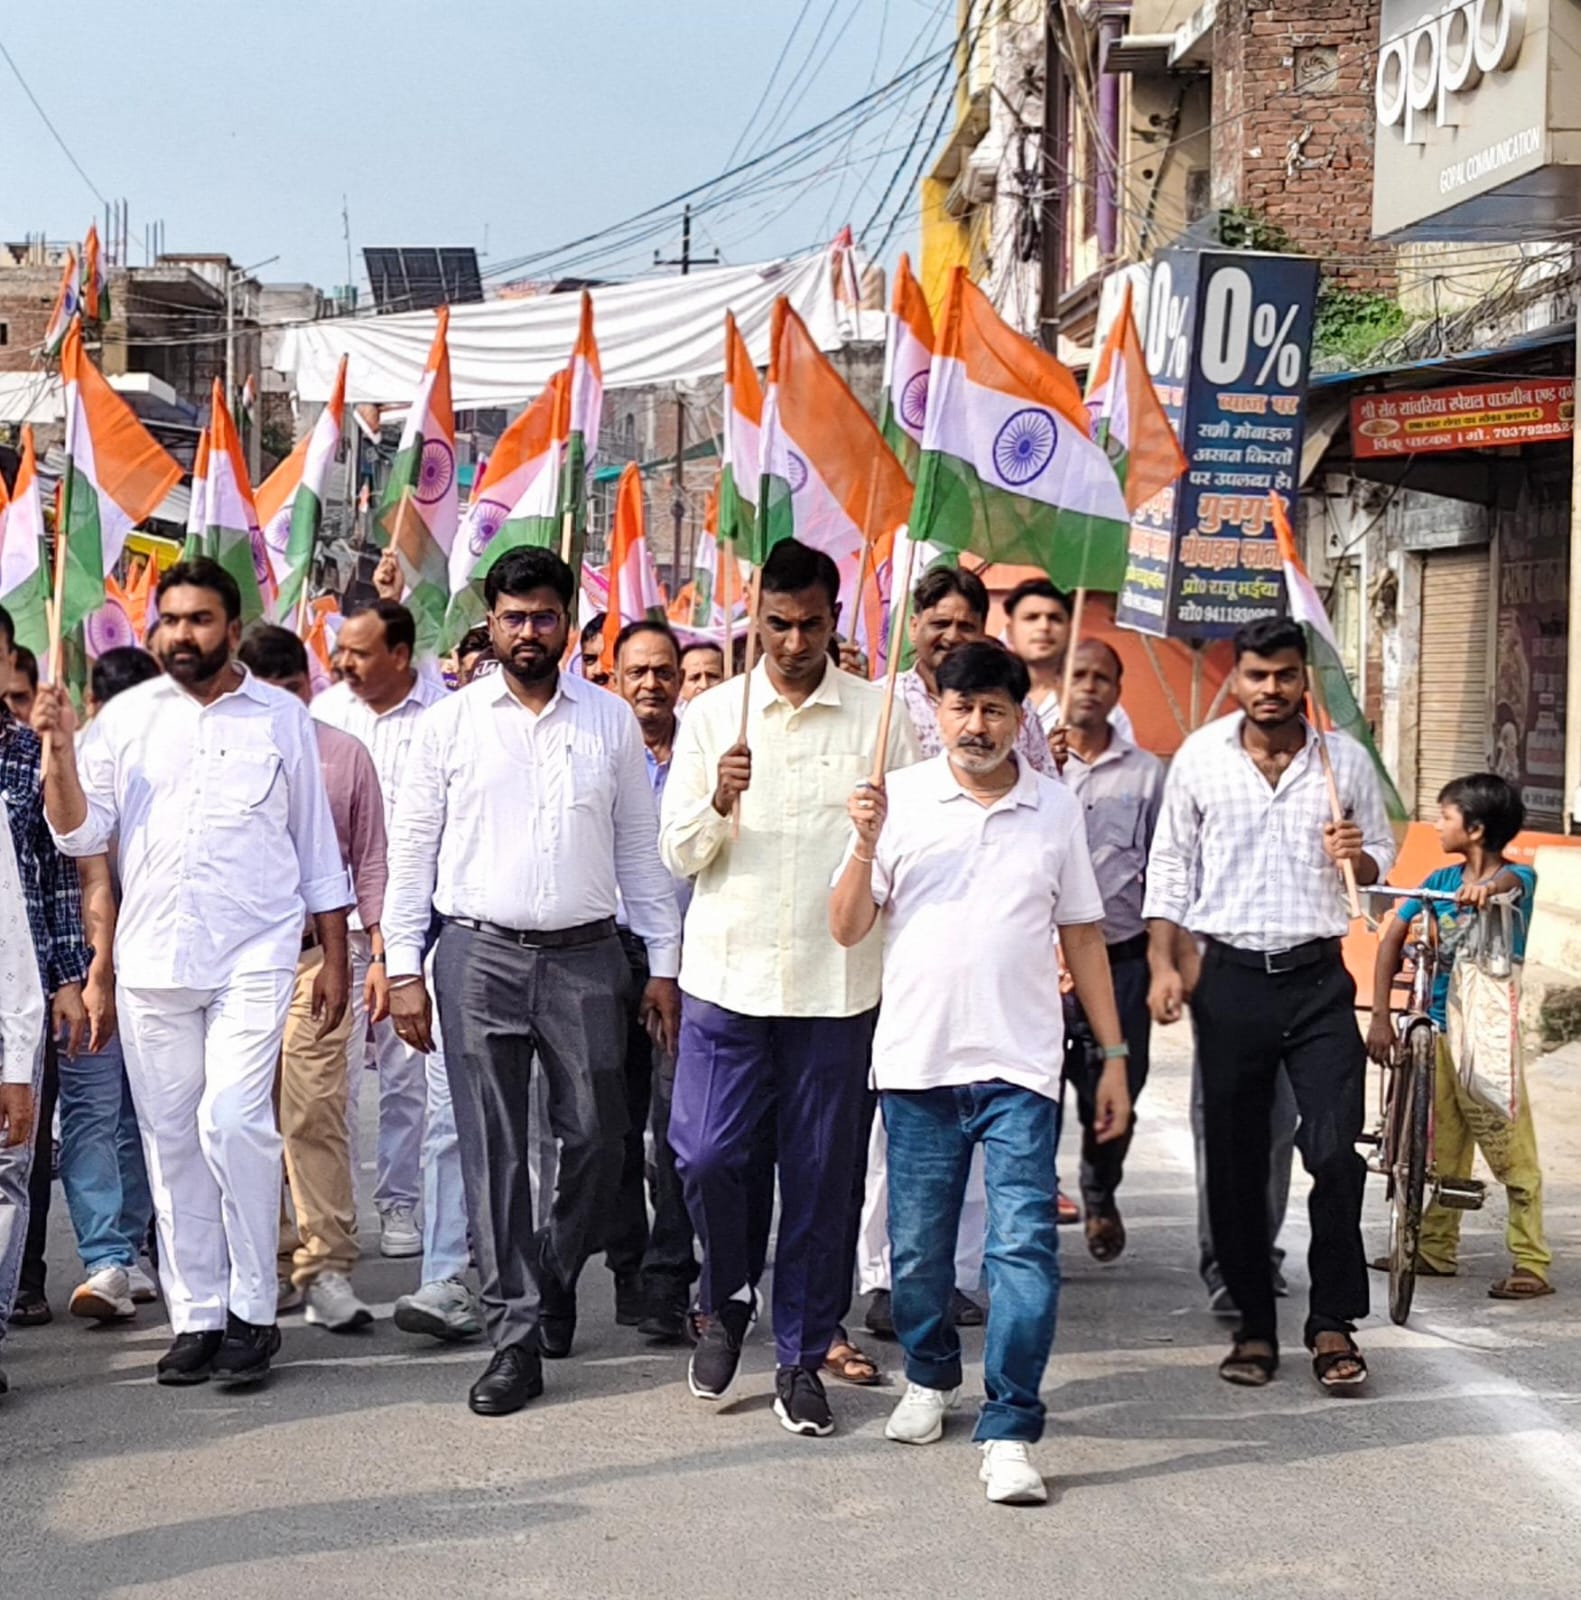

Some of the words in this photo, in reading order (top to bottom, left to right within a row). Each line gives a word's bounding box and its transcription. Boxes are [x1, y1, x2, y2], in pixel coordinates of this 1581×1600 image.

[1375, 0, 1520, 145] oppo
[1466, 127, 1540, 182] COMMUNICATION
[1146, 260, 1190, 379] 0%
[1201, 267, 1300, 388] 0%
[1233, 420, 1293, 442] मोबाइल
[1270, 394, 1300, 415] पर
[1189, 471, 1212, 486] पर
